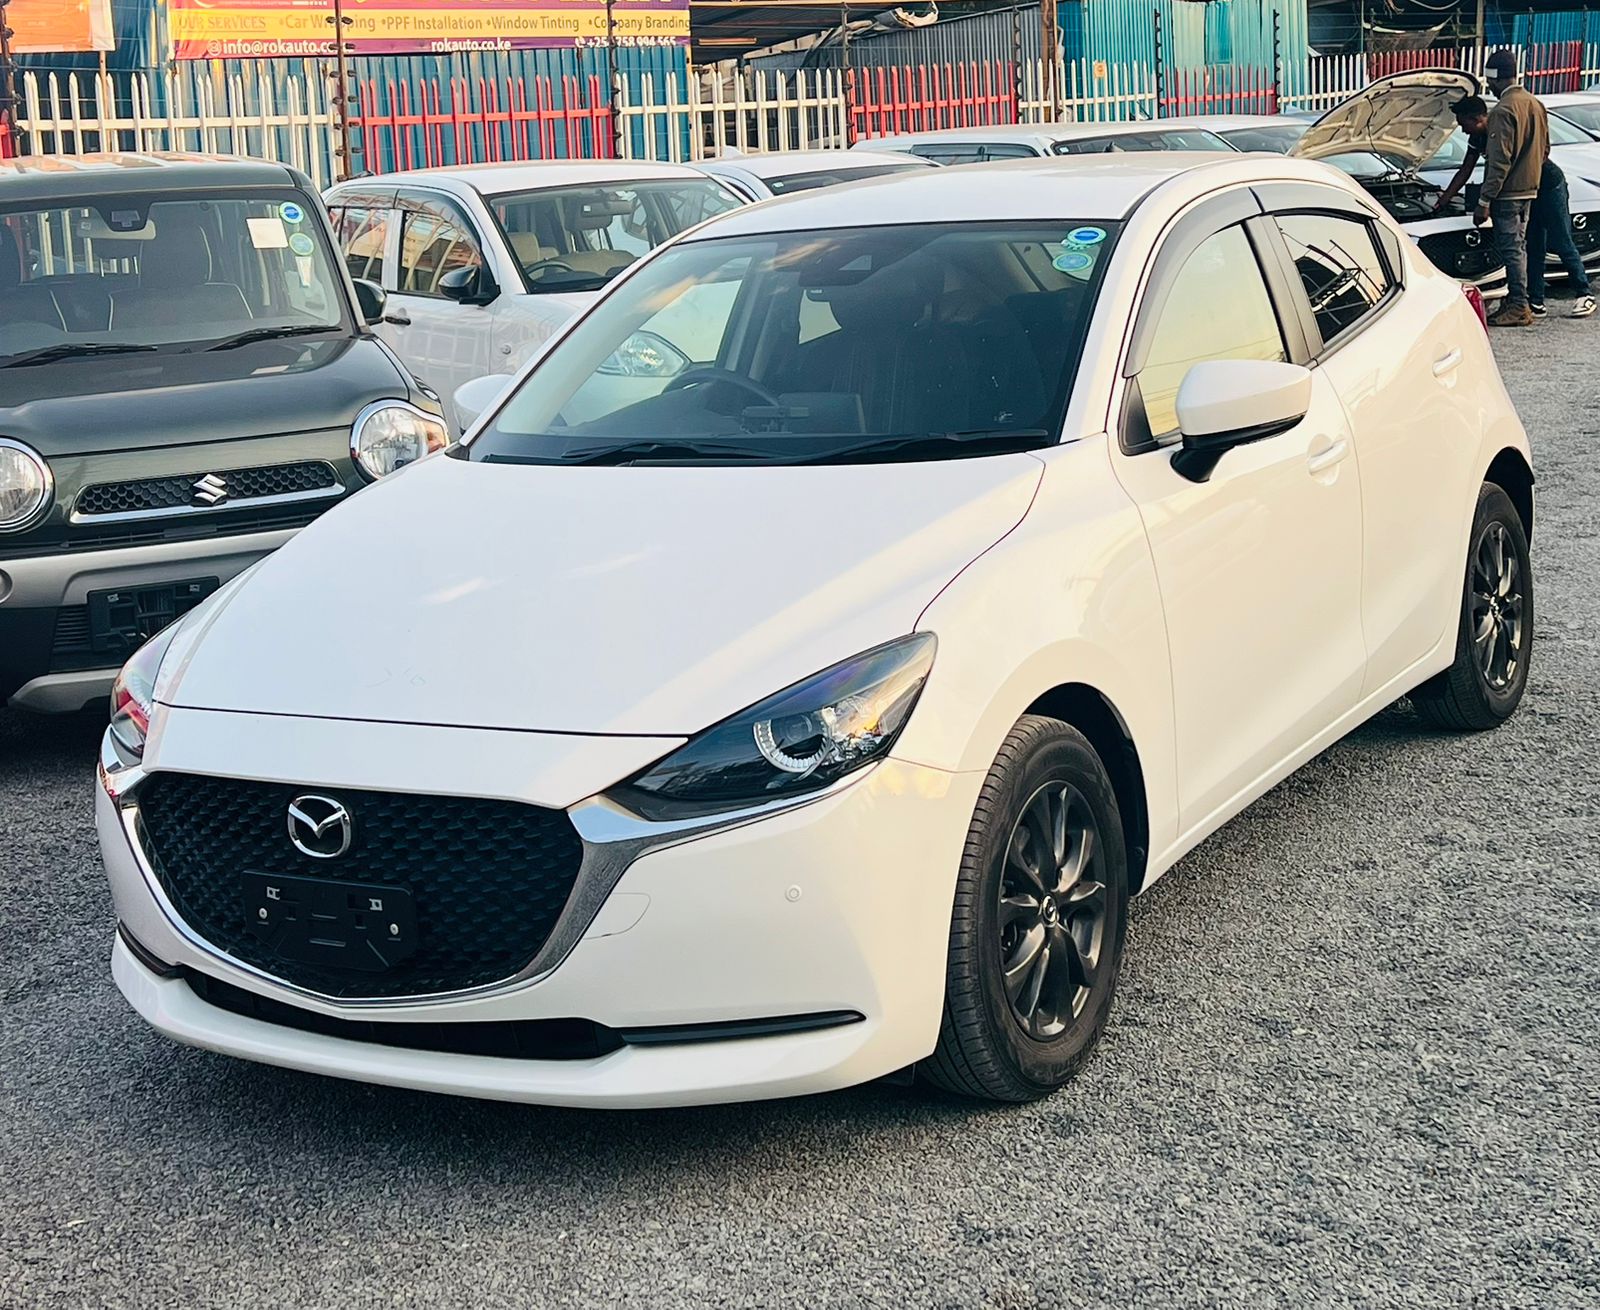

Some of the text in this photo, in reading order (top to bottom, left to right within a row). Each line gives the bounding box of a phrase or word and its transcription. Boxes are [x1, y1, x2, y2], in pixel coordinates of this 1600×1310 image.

[207, 15, 267, 30] SERVICES
[310, 14, 376, 33] Wping
[413, 16, 483, 30] Installation
[540, 16, 580, 32] Tinting
[593, 16, 643, 31] Copany
[223, 39, 354, 55] info@rokauto.co.
[431, 37, 512, 51] rokauto.co.ke
[587, 36, 611, 48] +25
